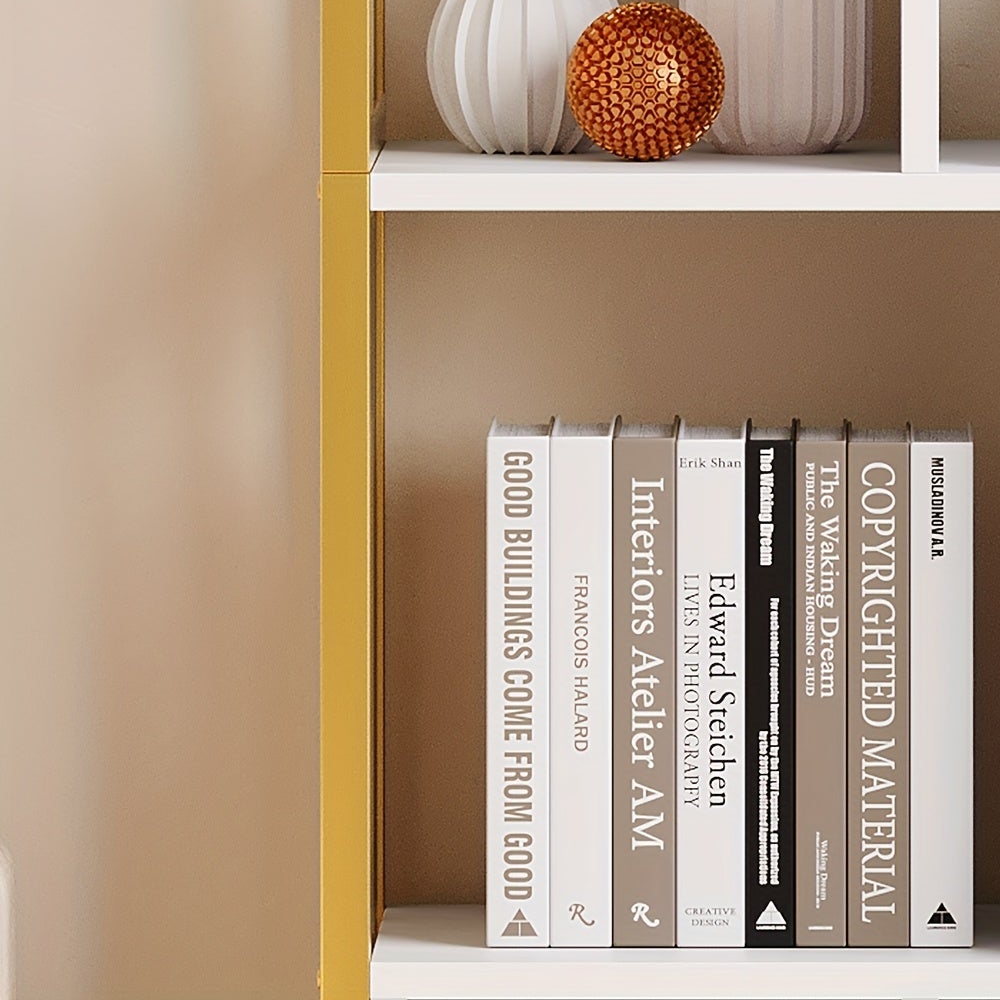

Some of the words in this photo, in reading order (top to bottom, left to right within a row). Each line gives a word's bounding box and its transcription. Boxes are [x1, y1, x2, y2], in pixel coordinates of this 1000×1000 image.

[503, 451, 533, 518] GOOD
[679, 457, 706, 469] Erik
[710, 457, 742, 469] Shan
[758, 447, 775, 472] The
[805, 462, 816, 511] PUBLIC
[819, 460, 840, 509] The
[758, 473, 775, 522] Waking
[805, 513, 816, 543] AND
[630, 477, 666, 635] Interiors
[759, 523, 775, 566] Dream
[805, 545, 816, 593] INDIAN
[816, 515, 840, 608] Waking
[503, 529, 533, 660] BUILDINGS
[573, 575, 589, 669] FRANCOIS
[683, 574, 700, 627] LIVES
[708, 572, 737, 680] Edward
[805, 594, 816, 656] HOUSING
[861, 462, 897, 728] COPYRIGHTED
[683, 634, 700, 656] IN
[819, 616, 840, 705] Dream
[503, 669, 533, 742] COME
[573, 676, 589, 752] HALARD
[630, 645, 667, 769] Atelier
[805, 666, 816, 697] HUD
[708, 689, 737, 809] Steichen
[503, 751, 533, 823] FROM
[630, 778, 665, 851] AM
[861, 736, 897, 923] MATERIAL
[503, 833, 533, 901] GOOD
[684, 907, 736, 916] CREATIVE
[691, 918, 730, 927] DESIGN
